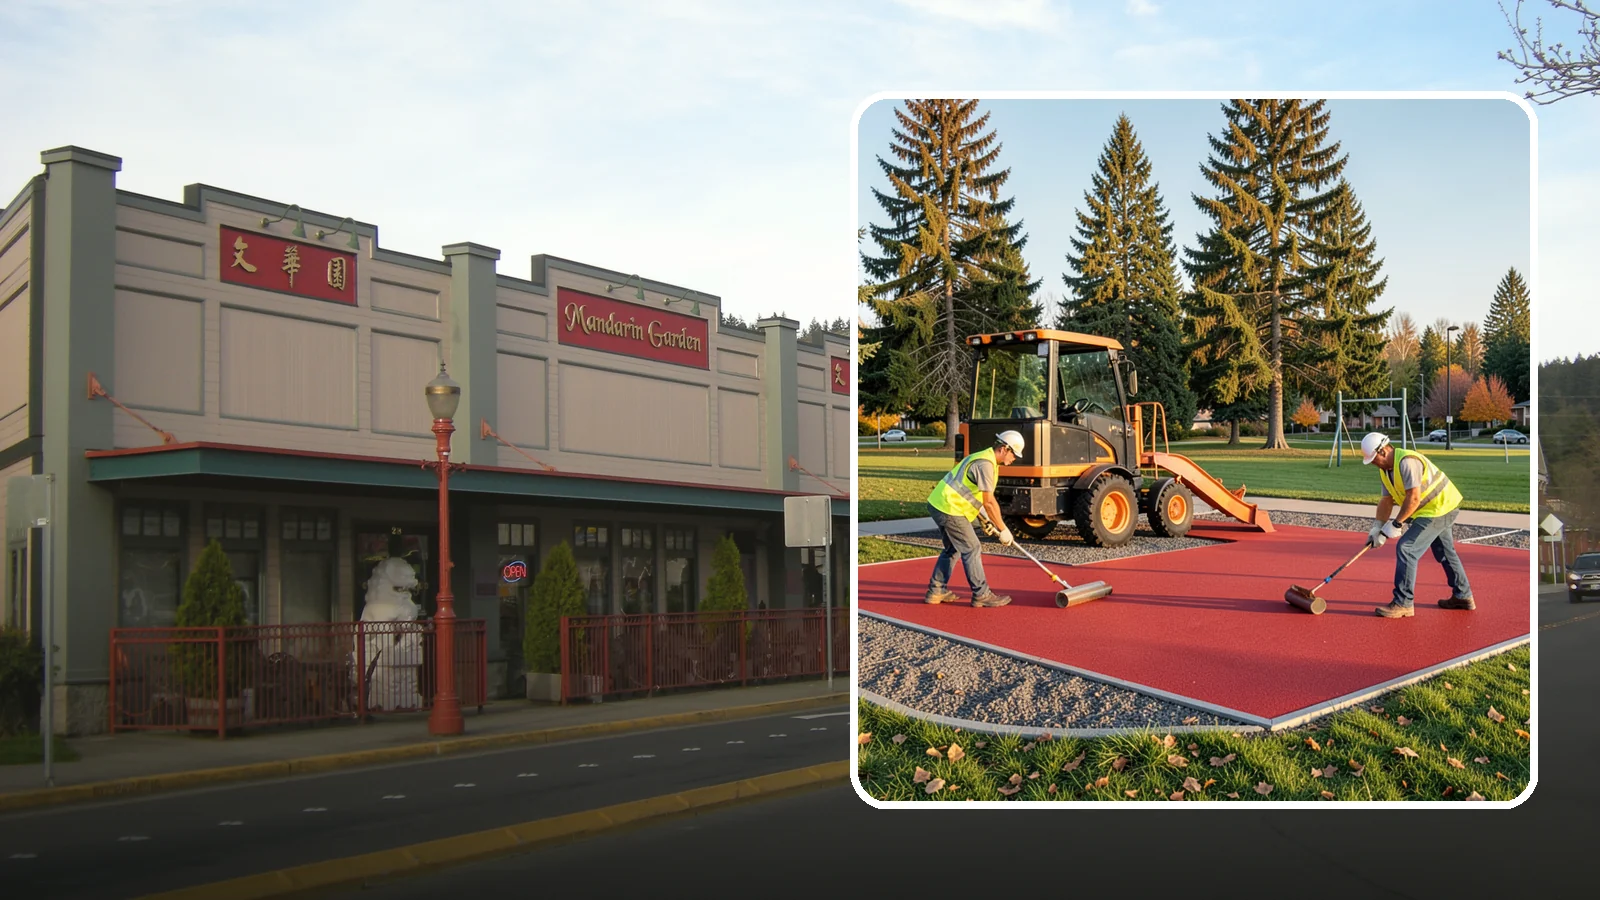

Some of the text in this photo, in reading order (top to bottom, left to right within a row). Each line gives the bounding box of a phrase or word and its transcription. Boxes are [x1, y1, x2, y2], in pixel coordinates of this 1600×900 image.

[564, 302, 701, 352] Mandarin Garden
[503, 565, 526, 578] OPEN
